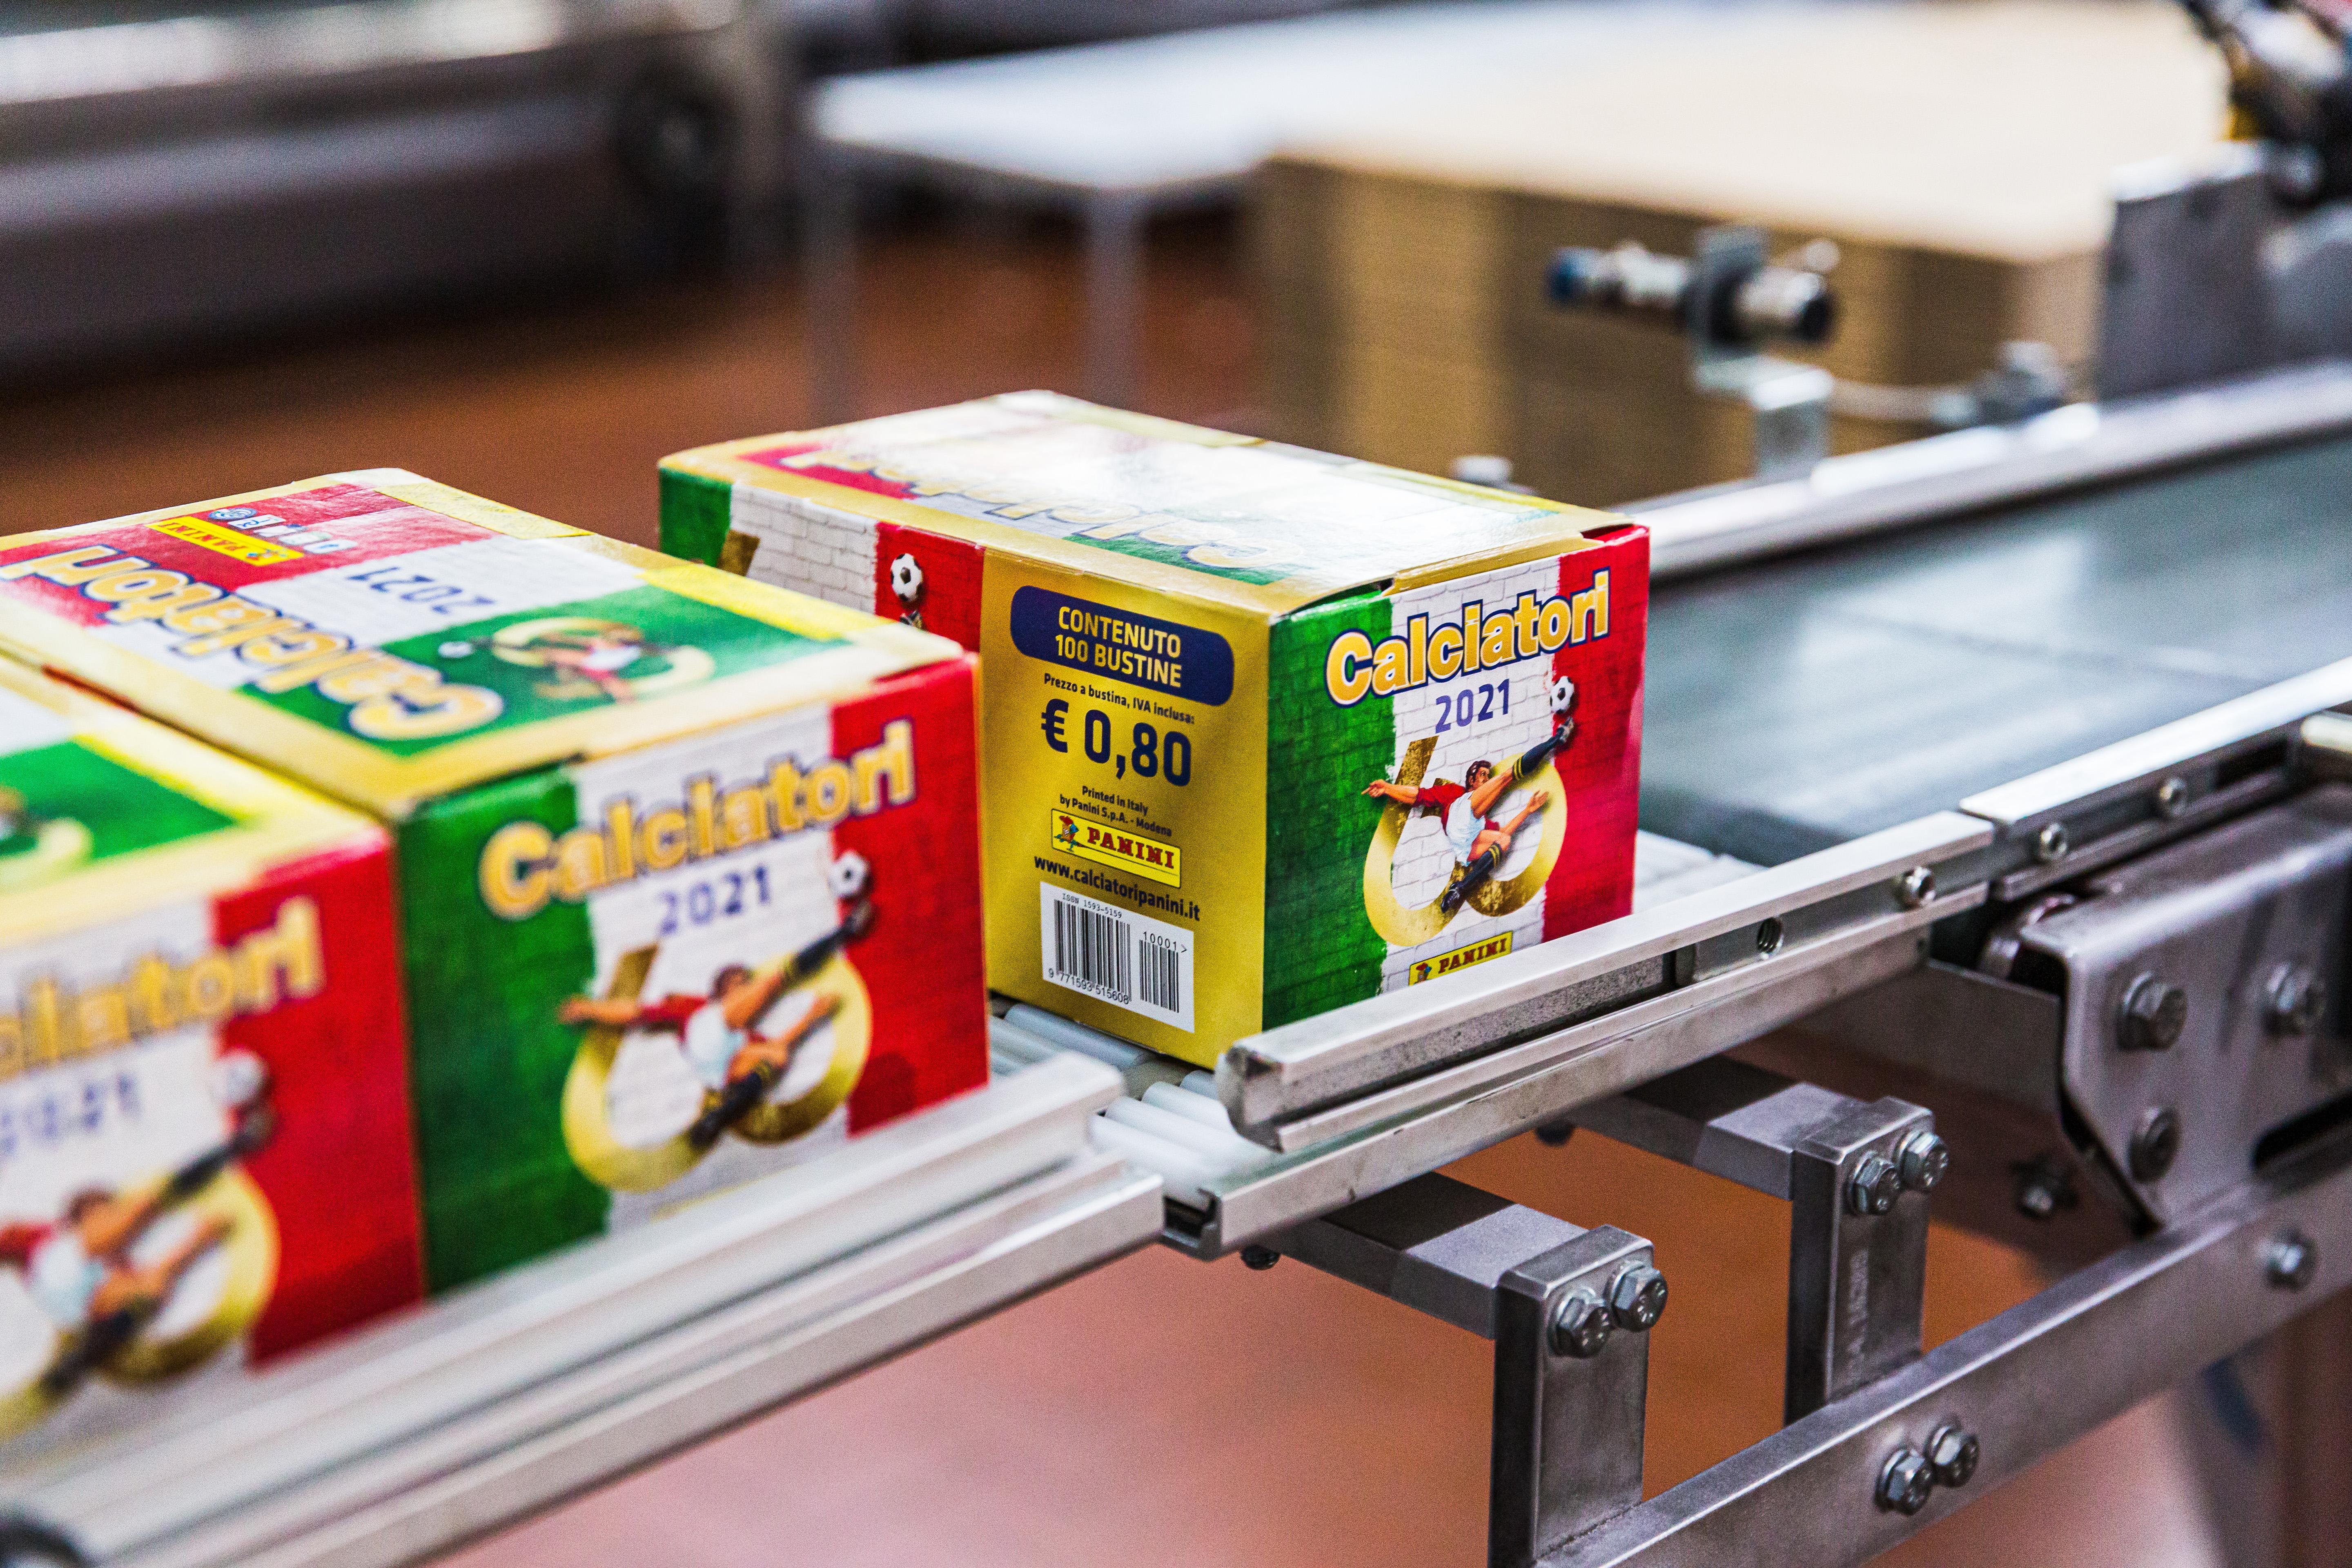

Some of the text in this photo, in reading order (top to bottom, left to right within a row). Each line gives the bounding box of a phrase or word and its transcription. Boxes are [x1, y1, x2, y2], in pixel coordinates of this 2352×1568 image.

[158, 522, 248, 551] PANINI
[347, 566, 497, 615] 2021
[1058, 606, 1181, 657] CONTENUTO
[1325, 567, 1611, 708] Calciatori
[1055, 634, 1182, 688] 100 BUSTINE
[1044, 673, 1195, 725] Prezzo a bustina, IVA inclusa:
[1434, 678, 1510, 733] 2021
[1084, 709, 1192, 787] 0,80
[478, 716, 917, 920] Calciatori
[1060, 794, 1071, 808] by
[1072, 797, 1100, 814] Panini
[1102, 804, 1128, 824] S.p.A.
[1136, 817, 1172, 837] Modena
[1082, 786, 1148, 816] Printed in Italy
[1087, 826, 1174, 870] PANINI
[658, 864, 771, 937] 2021
[1034, 856, 1200, 921] www.calciatoripanini.it
[1438, 938, 1507, 974] PANINI
